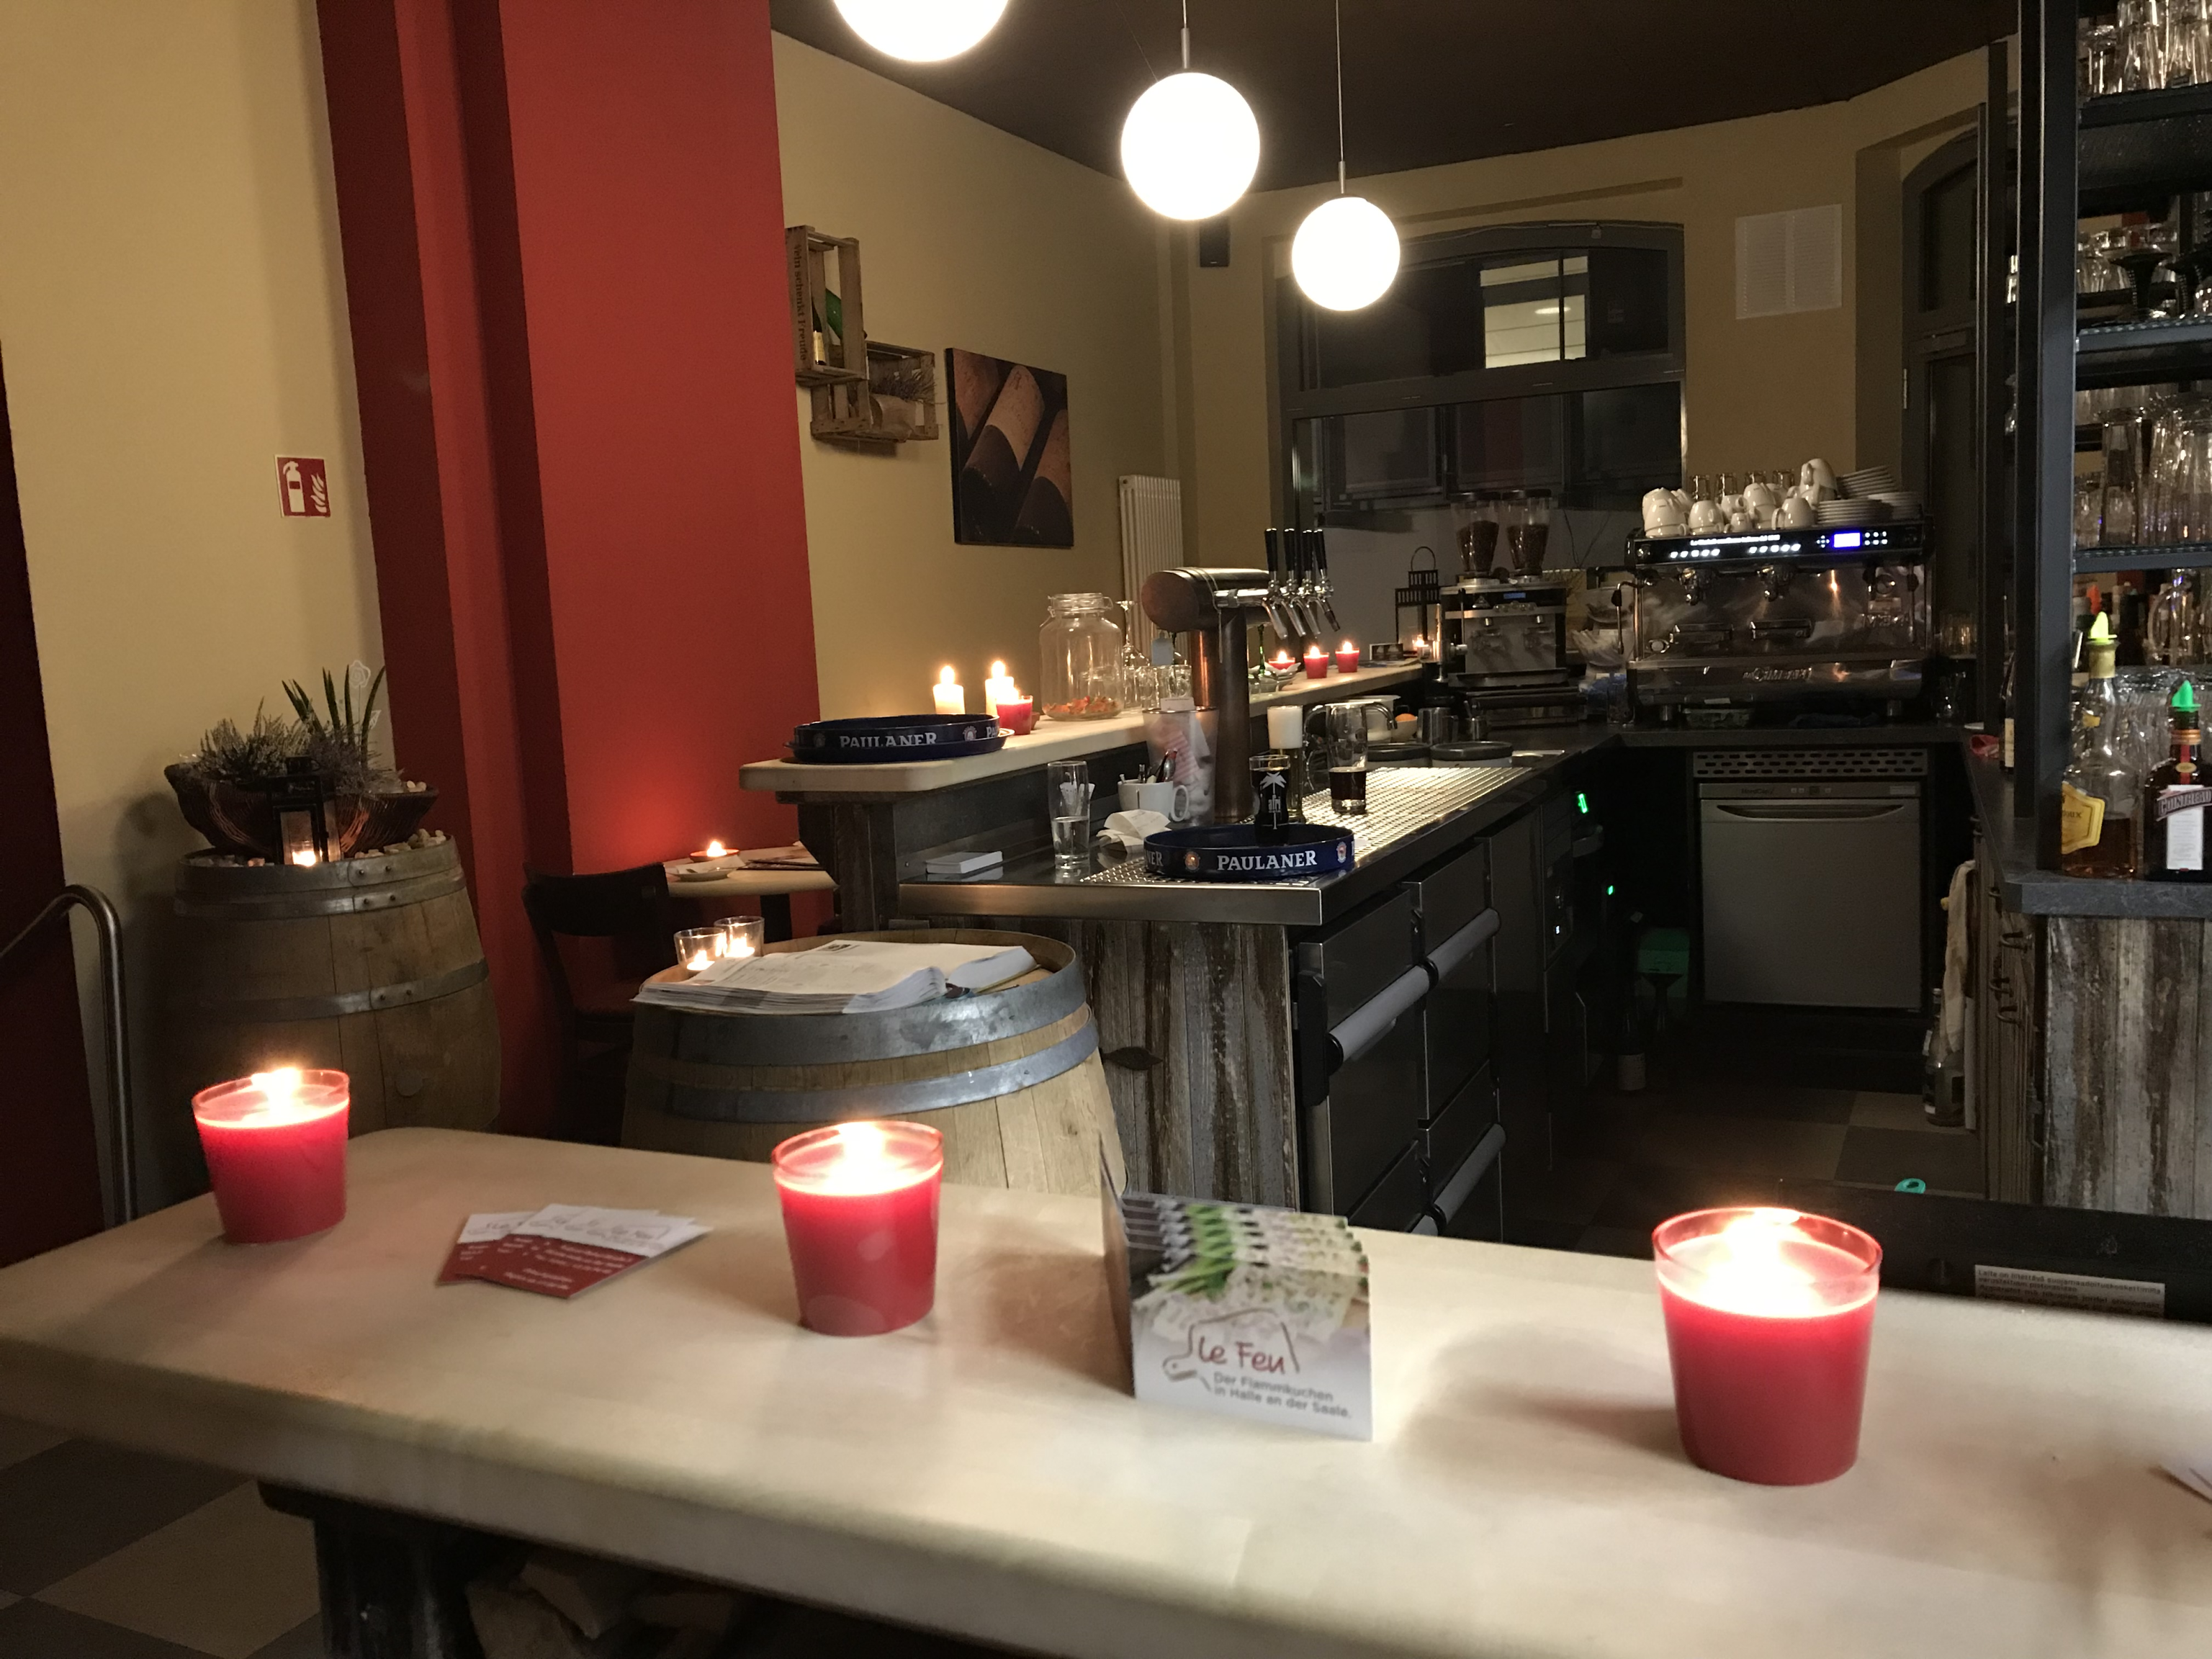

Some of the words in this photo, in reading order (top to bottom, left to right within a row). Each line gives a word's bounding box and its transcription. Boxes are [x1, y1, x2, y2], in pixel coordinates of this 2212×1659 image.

[795, 271, 805, 317] schenkt
[839, 732, 938, 748] PAULANER
[1268, 794, 1281, 810] afri
[1217, 850, 1318, 871] PAULANER
[1235, 1341, 1285, 1374] Feu
[1214, 1372, 1237, 1385] Der
[1241, 1376, 1334, 1401] Flammkuchen
[1214, 1386, 1226, 1397] in
[1230, 1388, 1262, 1403] Halle
[1266, 1395, 1282, 1406] an
[1286, 1398, 1308, 1411] der
